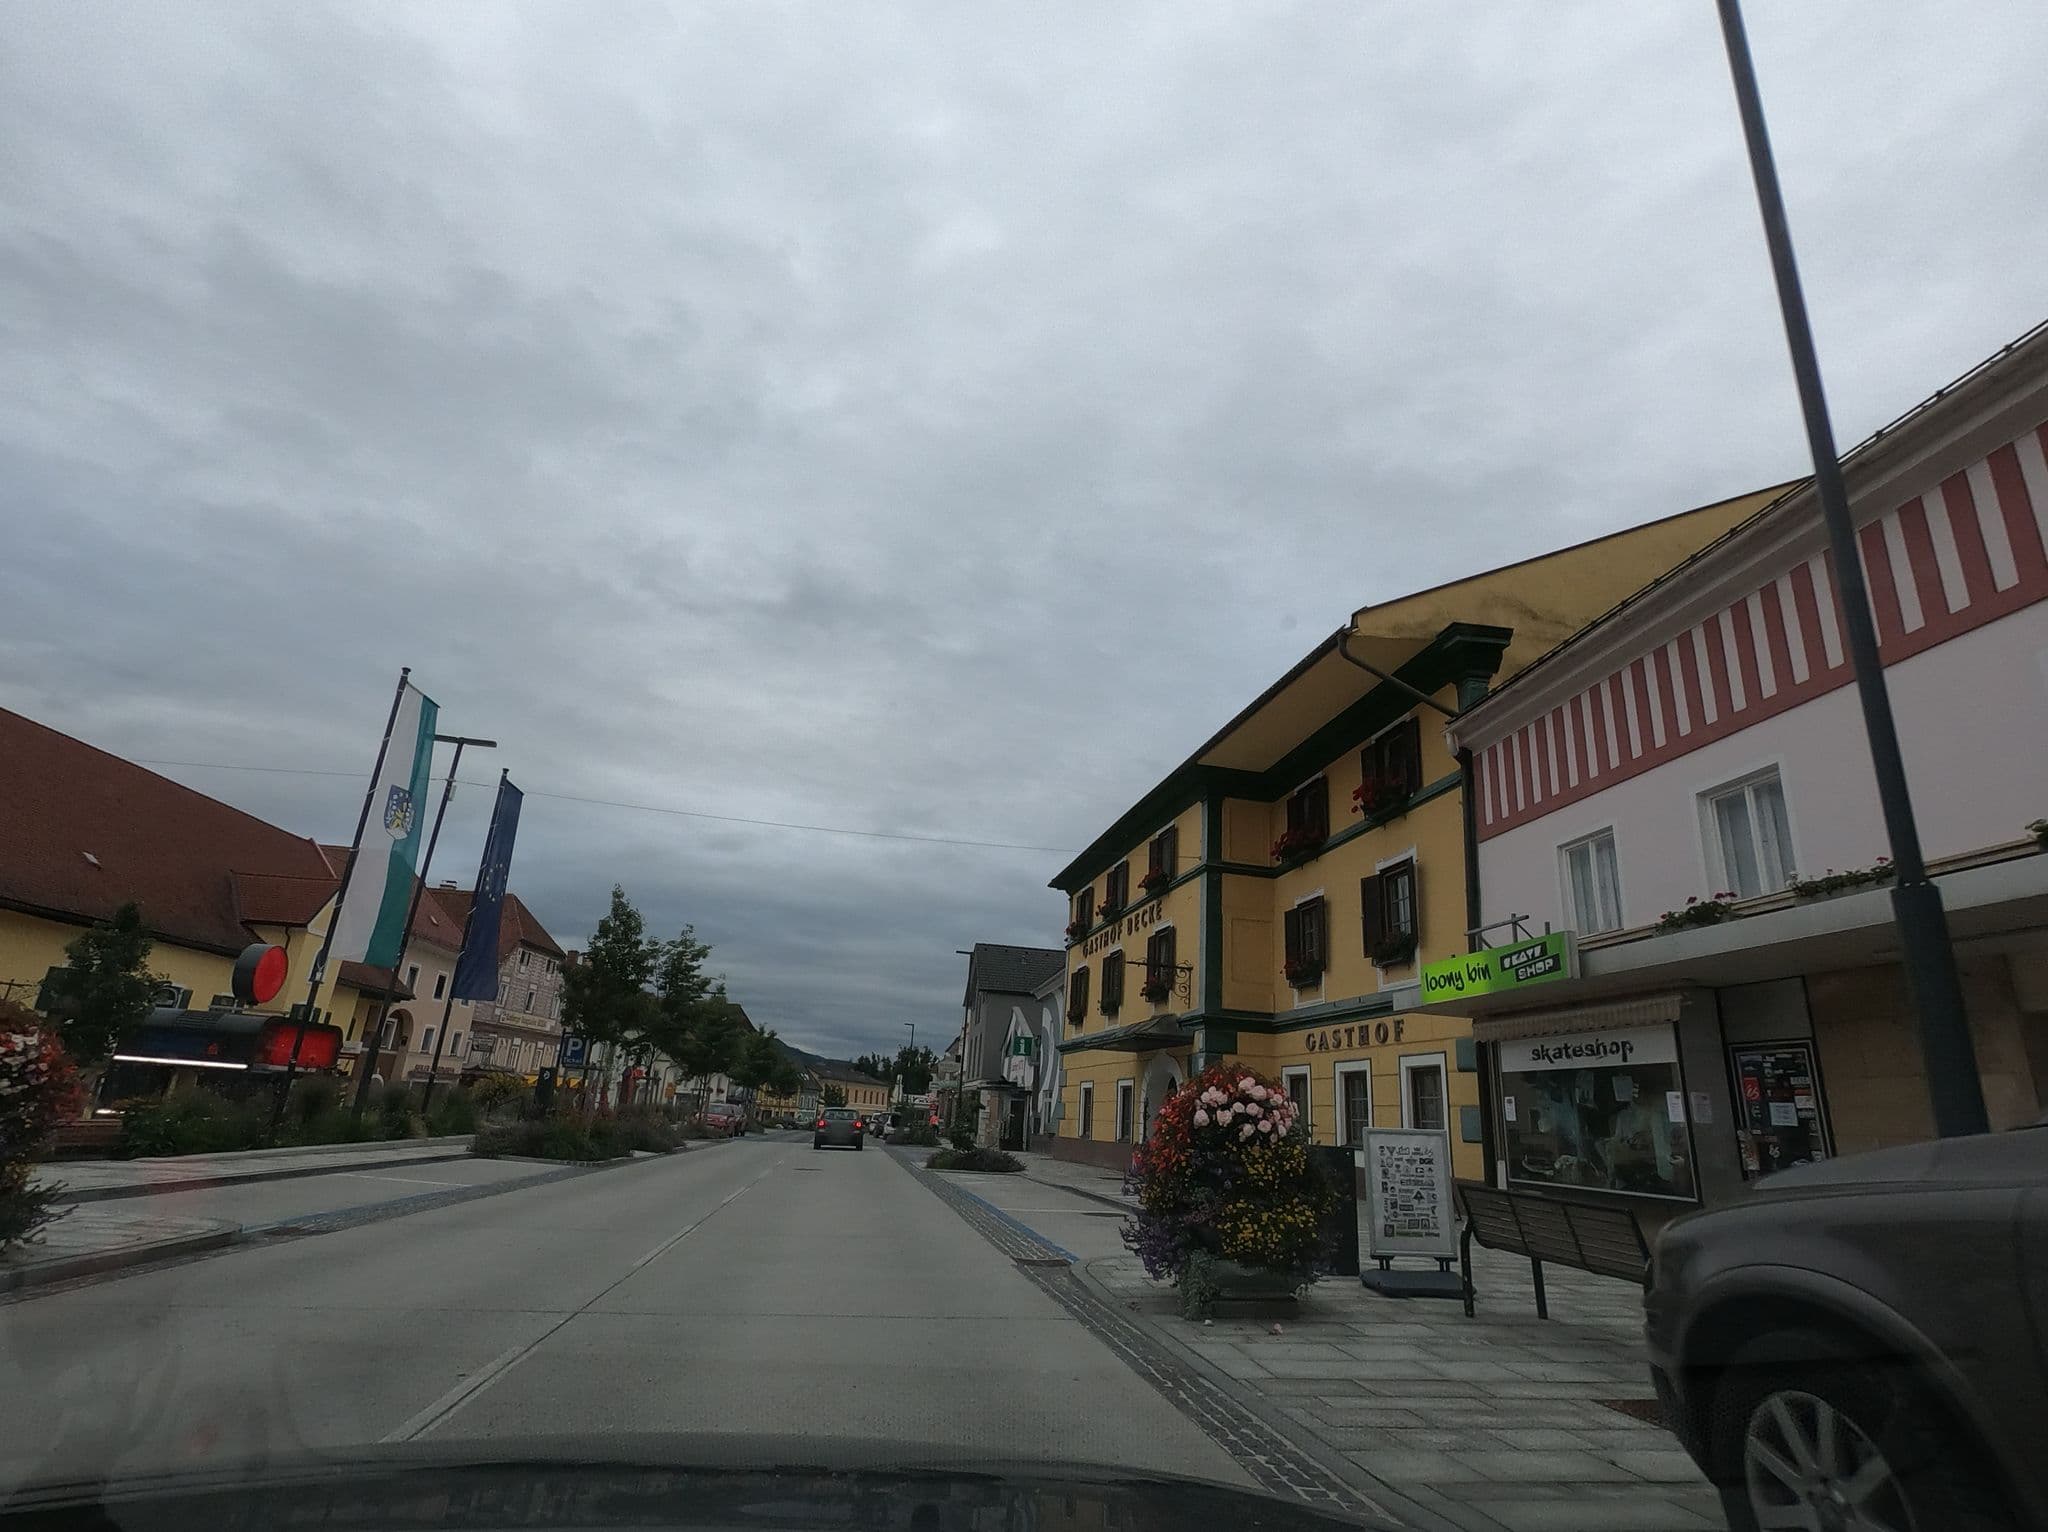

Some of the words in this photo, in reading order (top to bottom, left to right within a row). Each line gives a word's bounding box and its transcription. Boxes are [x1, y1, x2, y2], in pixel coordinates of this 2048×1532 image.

[1083, 920, 1123, 958] GASTHOF
[1424, 968, 1465, 992] loony
[1466, 962, 1491, 983] bin
[1517, 957, 1554, 980] SHOP
[566, 1038, 583, 1056] P
[1305, 1018, 1405, 1051] GASTHOF
[1531, 1038, 1633, 1063] skateshop
